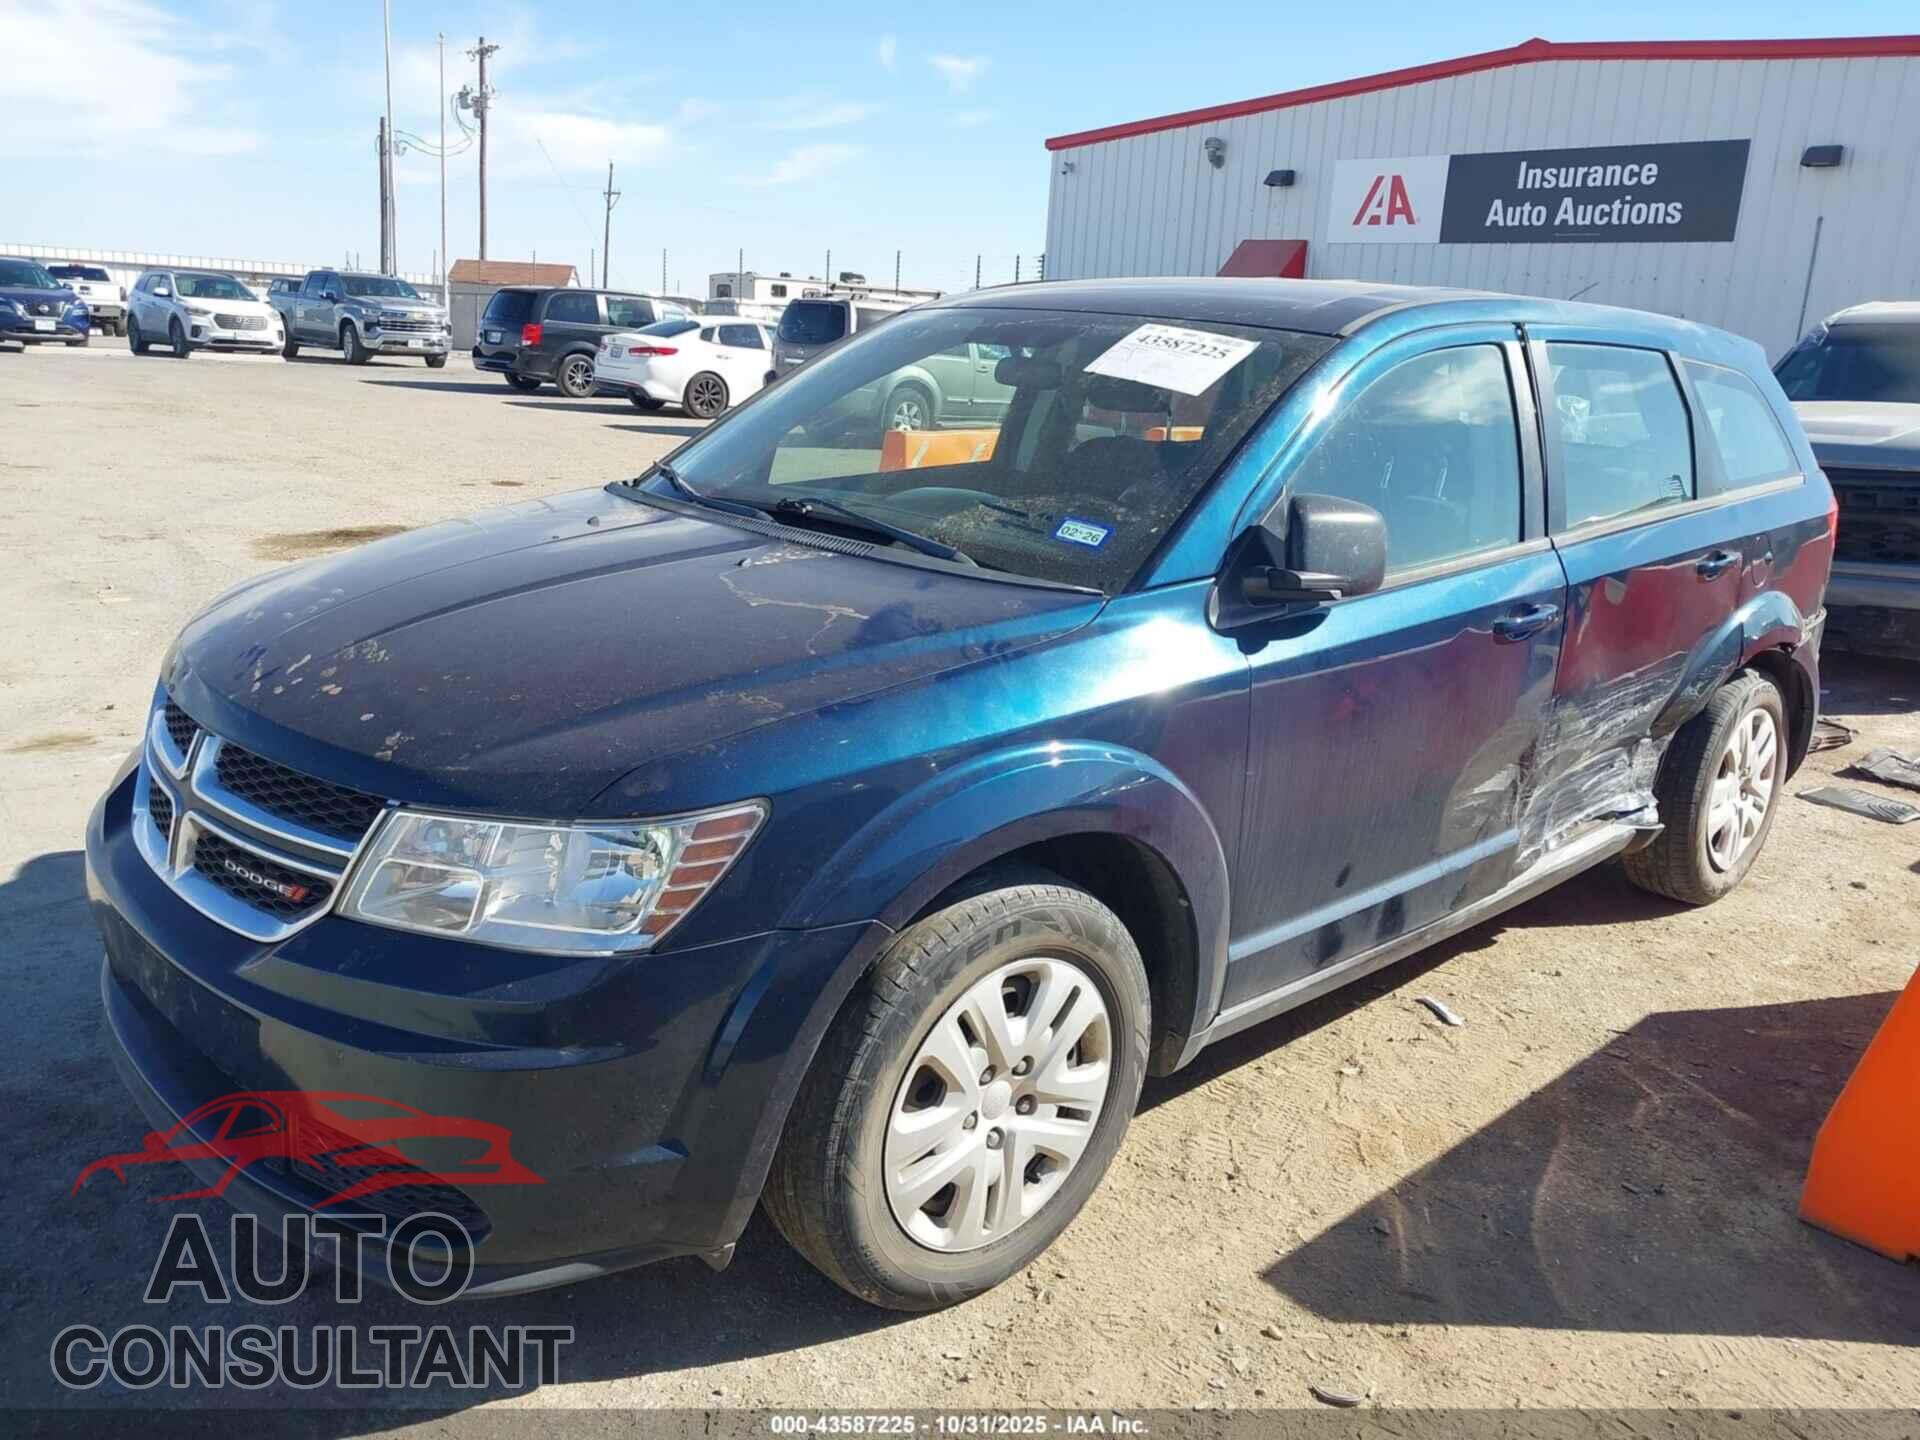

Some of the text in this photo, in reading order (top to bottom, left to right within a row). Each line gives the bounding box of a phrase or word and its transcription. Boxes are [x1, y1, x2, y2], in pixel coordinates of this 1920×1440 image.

[1517, 161, 1658, 190] Insurance
[1485, 194, 1683, 227] Auto Auctions
[1136, 334, 1233, 360] 43587225
[225, 859, 292, 897] DODGE
